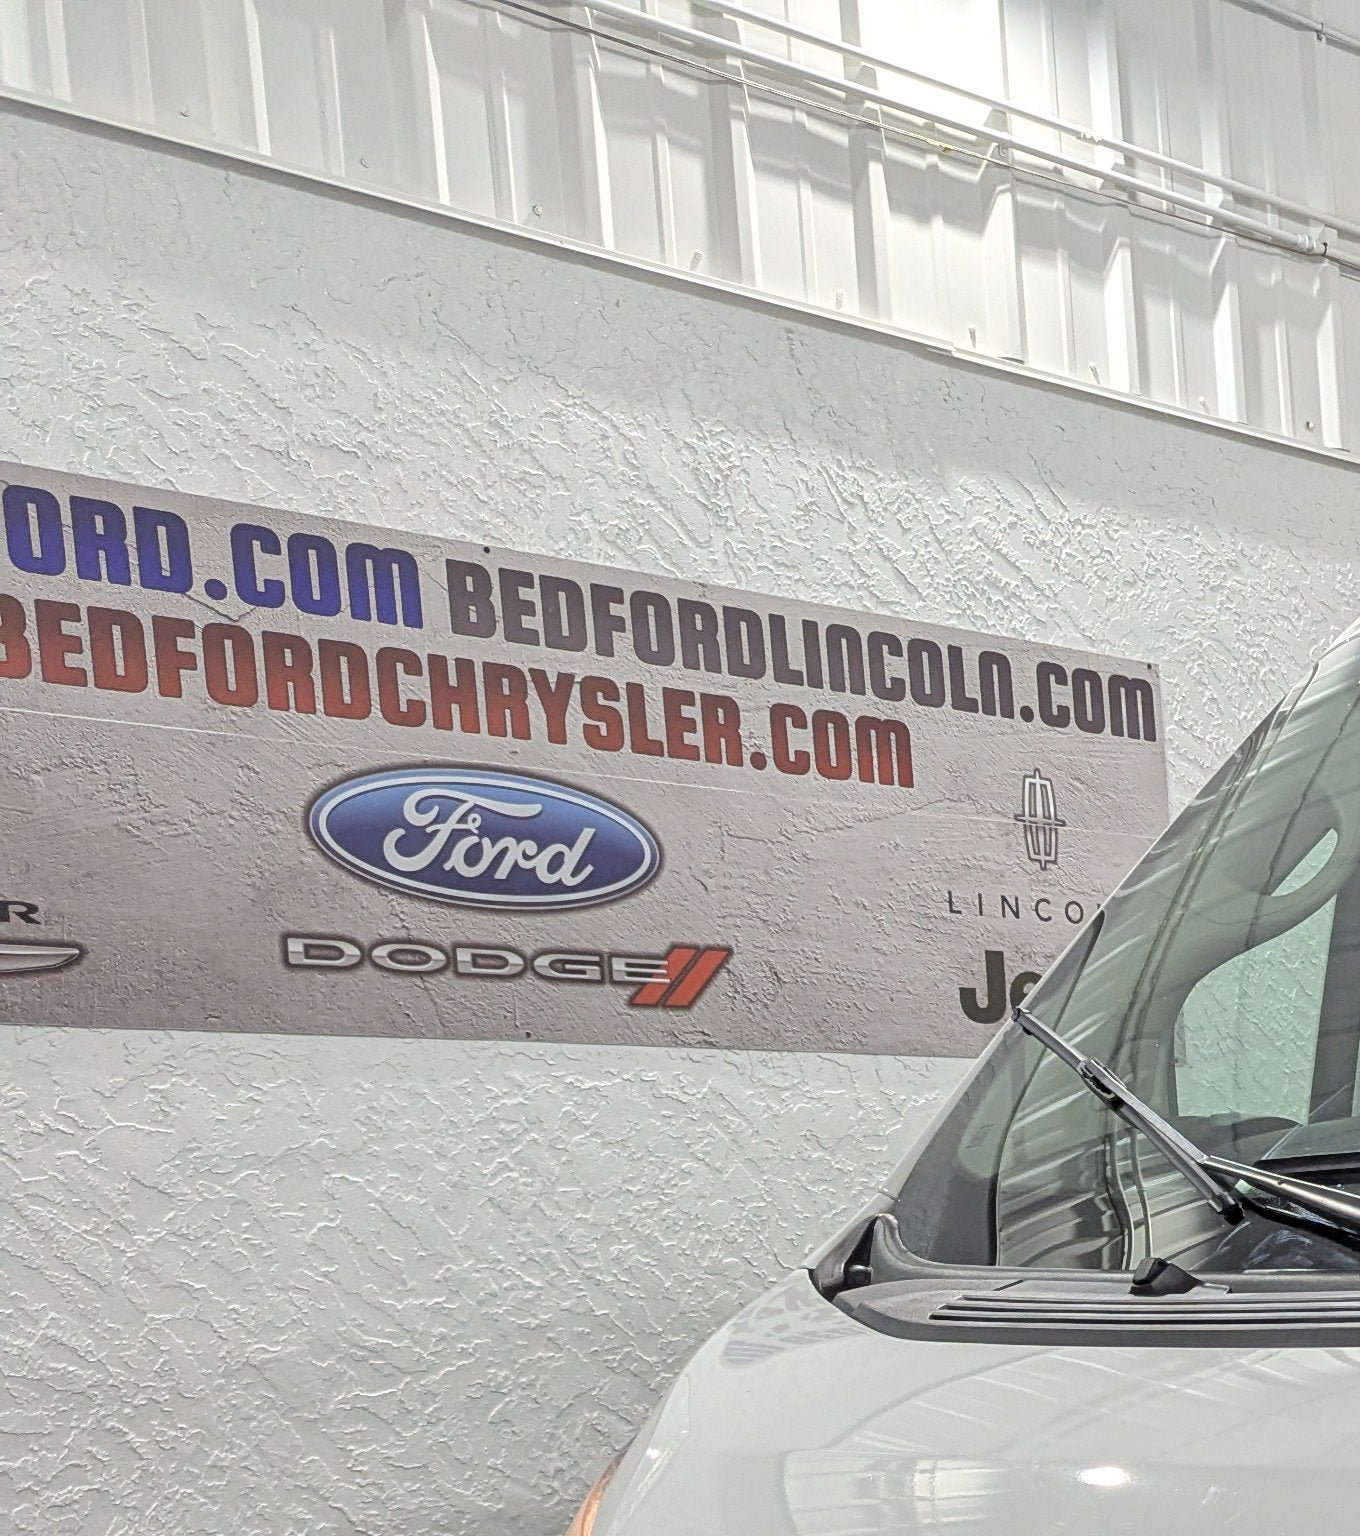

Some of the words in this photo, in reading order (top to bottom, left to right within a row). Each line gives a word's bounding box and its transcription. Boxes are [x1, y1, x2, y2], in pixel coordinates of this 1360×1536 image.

[0, 592, 915, 789] BEDFORDCHRYSLER.COM
[445, 558, 1158, 742] BEDFORDLINCOLN.COM
[382, 787, 595, 888] Ford
[947, 890, 1103, 925] LINCO
[286, 936, 671, 983] DODGE
